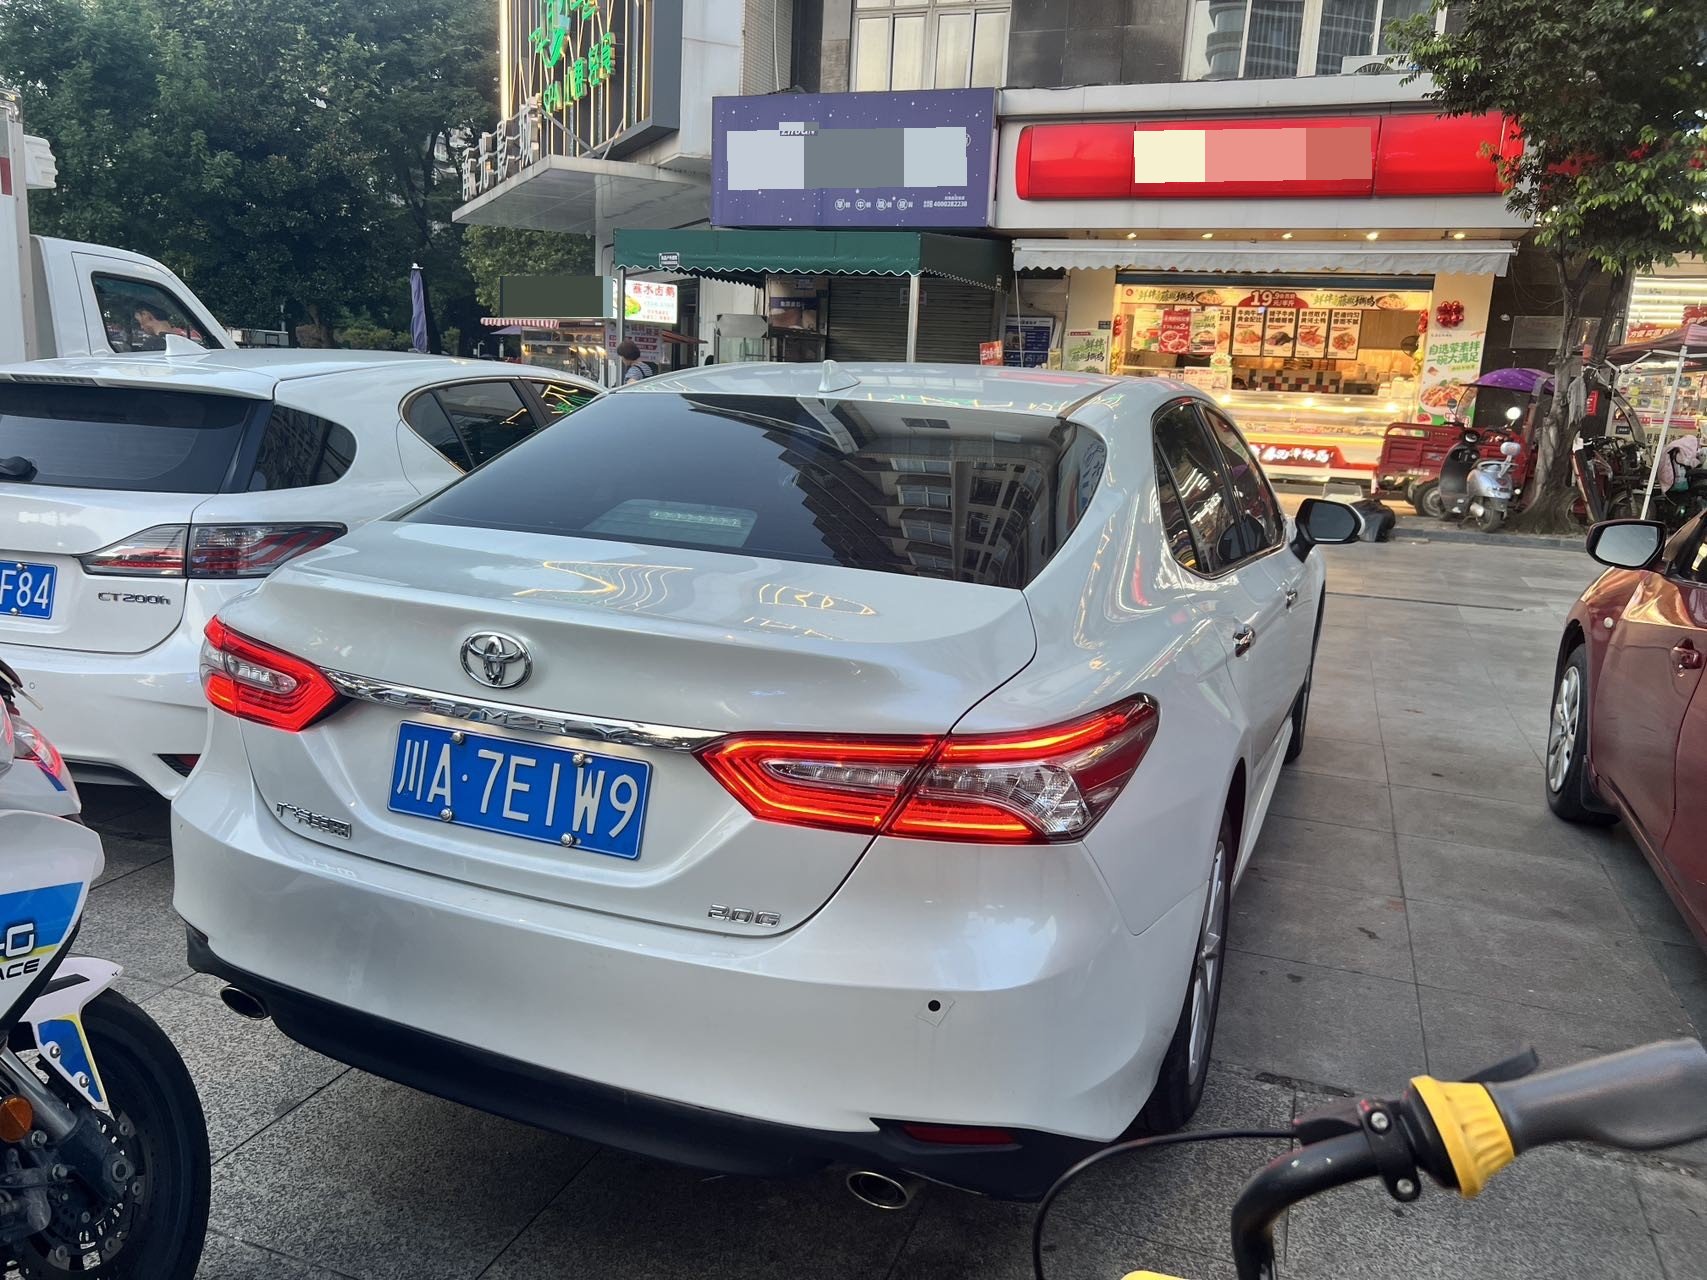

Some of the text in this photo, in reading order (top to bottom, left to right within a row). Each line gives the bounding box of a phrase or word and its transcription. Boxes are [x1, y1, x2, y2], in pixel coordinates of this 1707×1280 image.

[1238, 309, 1263, 317] 牛肉牛
[1429, 341, 1480, 356] 自选荤素拌
[1427, 352, 1479, 366] 一碗大满足
[98, 591, 171, 606] CT200h
[277, 802, 352, 840] 广汽丰田
